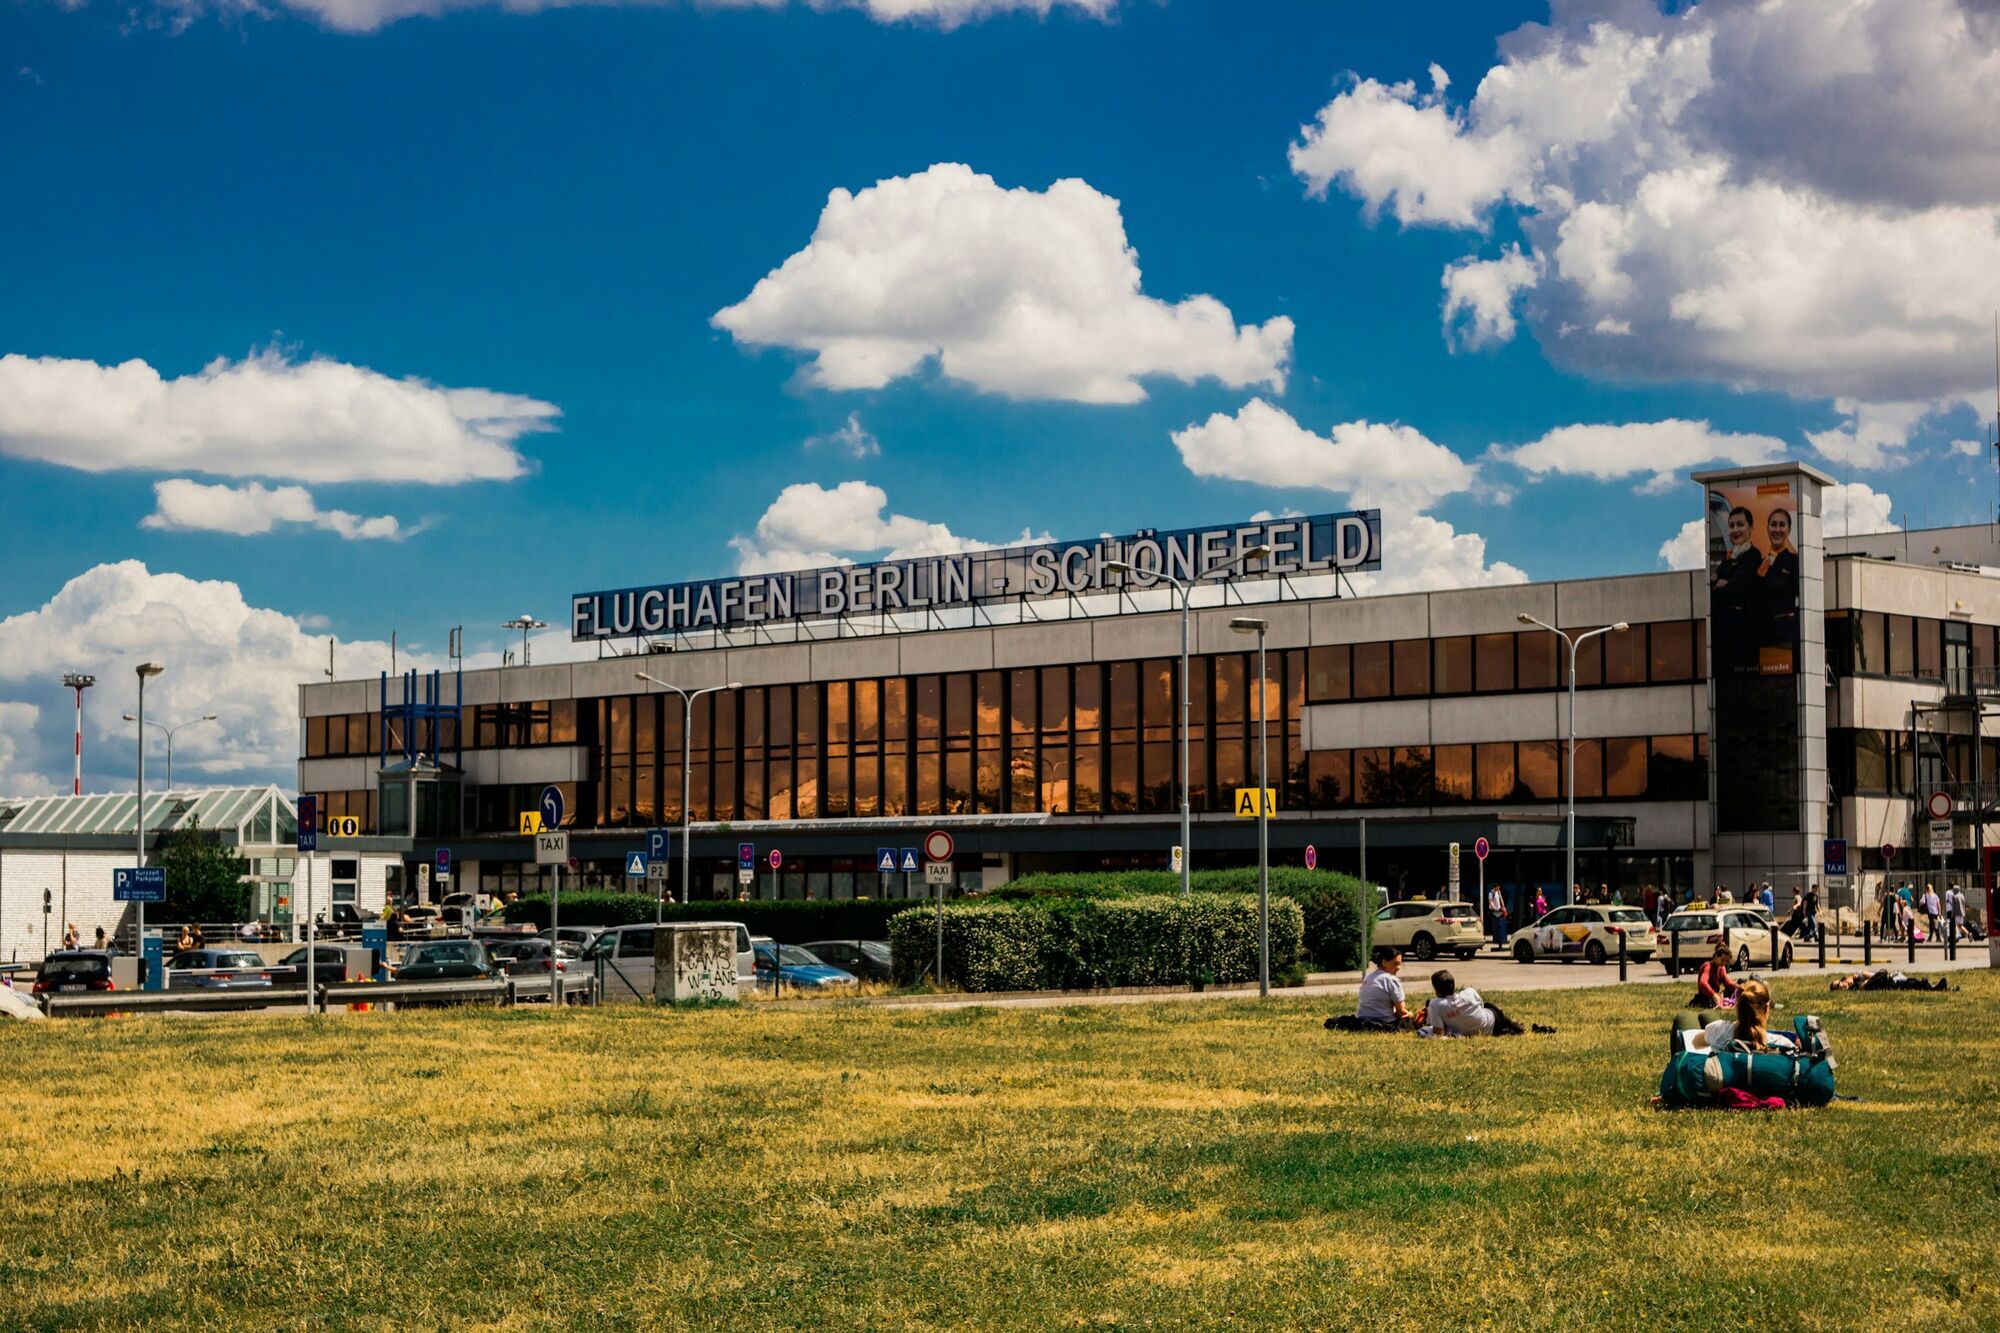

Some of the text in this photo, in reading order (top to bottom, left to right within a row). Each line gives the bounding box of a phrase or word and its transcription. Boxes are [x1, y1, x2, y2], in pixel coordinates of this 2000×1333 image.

[572, 575, 795, 637] FLUGHAFEN
[820, 556, 971, 615] BERLIN
[1028, 516, 1371, 596] SCHÖNEFELD
[1239, 792, 1254, 814] A
[522, 815, 533, 832] A
[299, 834, 315, 847] TAXI
[540, 837, 564, 851] TAXI
[652, 834, 664, 858] P
[928, 865, 949, 875] TAXI
[1826, 863, 1846, 873] TAXI
